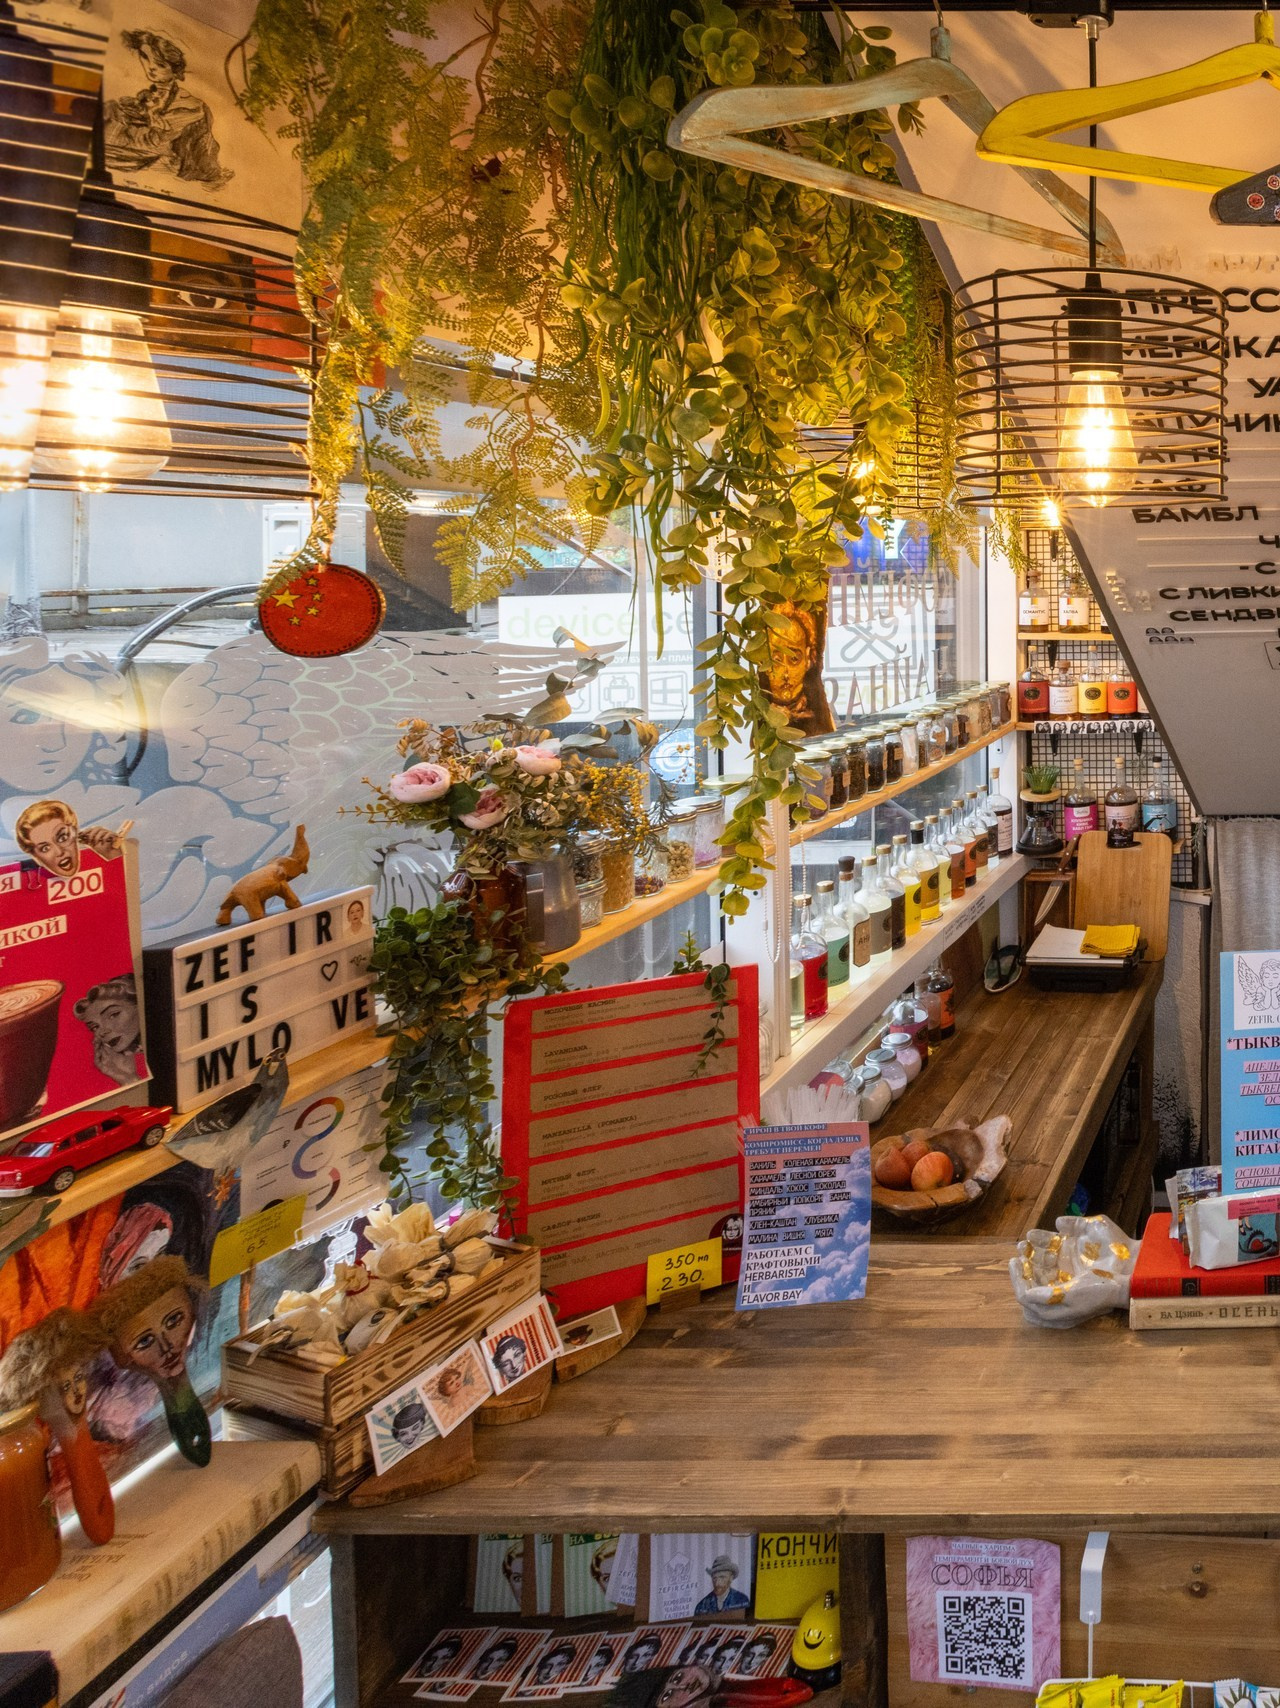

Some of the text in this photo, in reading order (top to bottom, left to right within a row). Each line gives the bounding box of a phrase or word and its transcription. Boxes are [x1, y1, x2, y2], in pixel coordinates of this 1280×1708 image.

[1131, 505, 1259, 524] БАМБЛ
[506, 606, 638, 640] device
[49, 872, 102, 902] 200
[808, 1136, 859, 1146] КОГДА ДУША
[745, 1144, 822, 1157] ТРЕБУЕТ ПЕРЕМЕН
[750, 1161, 776, 1170] ВАНИЛЬ
[815, 1156, 850, 1166] КАРАМЕЛЬ
[750, 1169, 836, 1184] КАРАМЕЛЬ ОРЕХ
[1235, 1167, 1276, 1179] ОСНОВА
[750, 1181, 846, 1196] МИНДАЛЬ КОКОС ШОКОЛАД
[794, 1192, 851, 1205] ПОПКОРН БАНАН
[750, 1207, 776, 1217] ПРЯНИК
[804, 1214, 839, 1225] КЛУБНИКА
[749, 1233, 778, 1244] МАЛИНА
[815, 1228, 834, 1238] МЯТА
[746, 1246, 813, 1261] РАБОТАЕМ С
[664, 1252, 695, 1271] 350
[745, 1256, 821, 1272] КРАФТОВЫМИ
[744, 1268, 806, 1282] HERBARISTA
[743, 1284, 751, 1293] И
[741, 1289, 803, 1305] FLAVOR BAY
[1174, 1310, 1204, 1321] ЦЗИНЬ
[1218, 1306, 1279, 1319] ОСЕНЬ
[935, 1555, 984, 1563] ТЕМПЕРАМЕНТ
[930, 1563, 1034, 1589] СОФЬЯ
